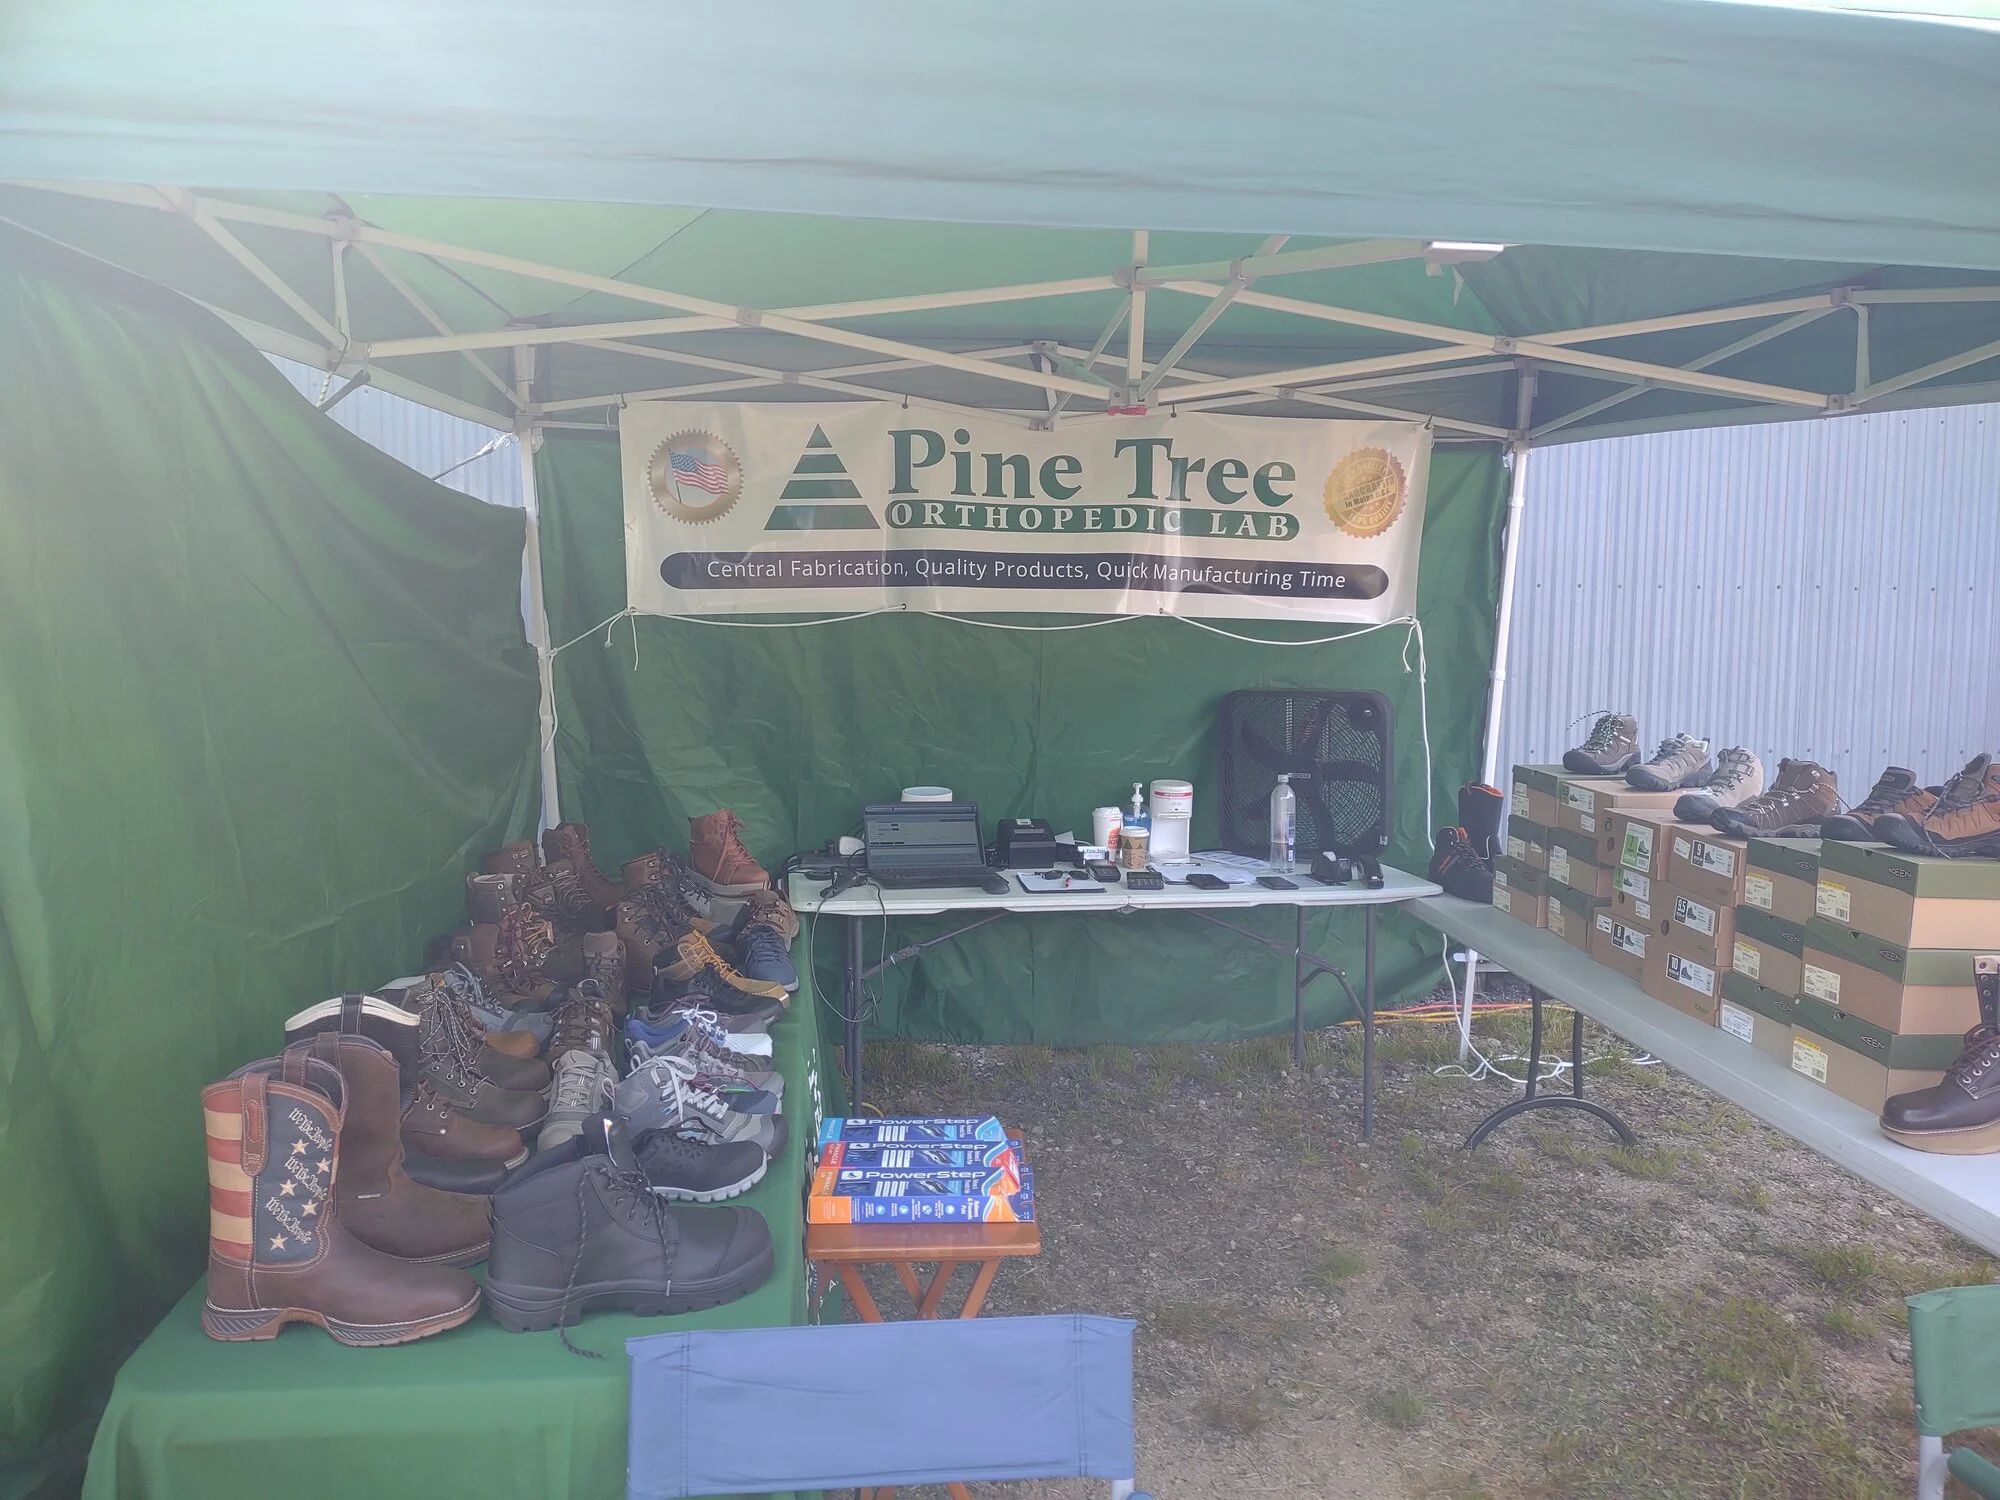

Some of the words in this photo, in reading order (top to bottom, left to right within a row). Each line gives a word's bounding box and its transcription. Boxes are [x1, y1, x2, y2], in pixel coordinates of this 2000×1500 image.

[888, 429, 1083, 500] Pine
[1114, 438, 1296, 507] Tree
[891, 502, 1182, 532] ORTHOPEDIC
[1209, 512, 1290, 538] LAB
[707, 560, 783, 578] Central
[791, 560, 909, 580] Fabrication,
[915, 558, 988, 581] Quality
[995, 561, 1090, 581] Products,
[1097, 559, 1149, 581] Quick
[1153, 563, 1293, 591] Manufacturing
[1299, 571, 1346, 589] Time
[1888, 866, 1912, 880] KEEN
[1879, 949, 1902, 962] KEEN
[1860, 1035, 1885, 1049] KEEN
[868, 1118, 979, 1126] PowerStep
[865, 1171, 987, 1179] PowerStep
